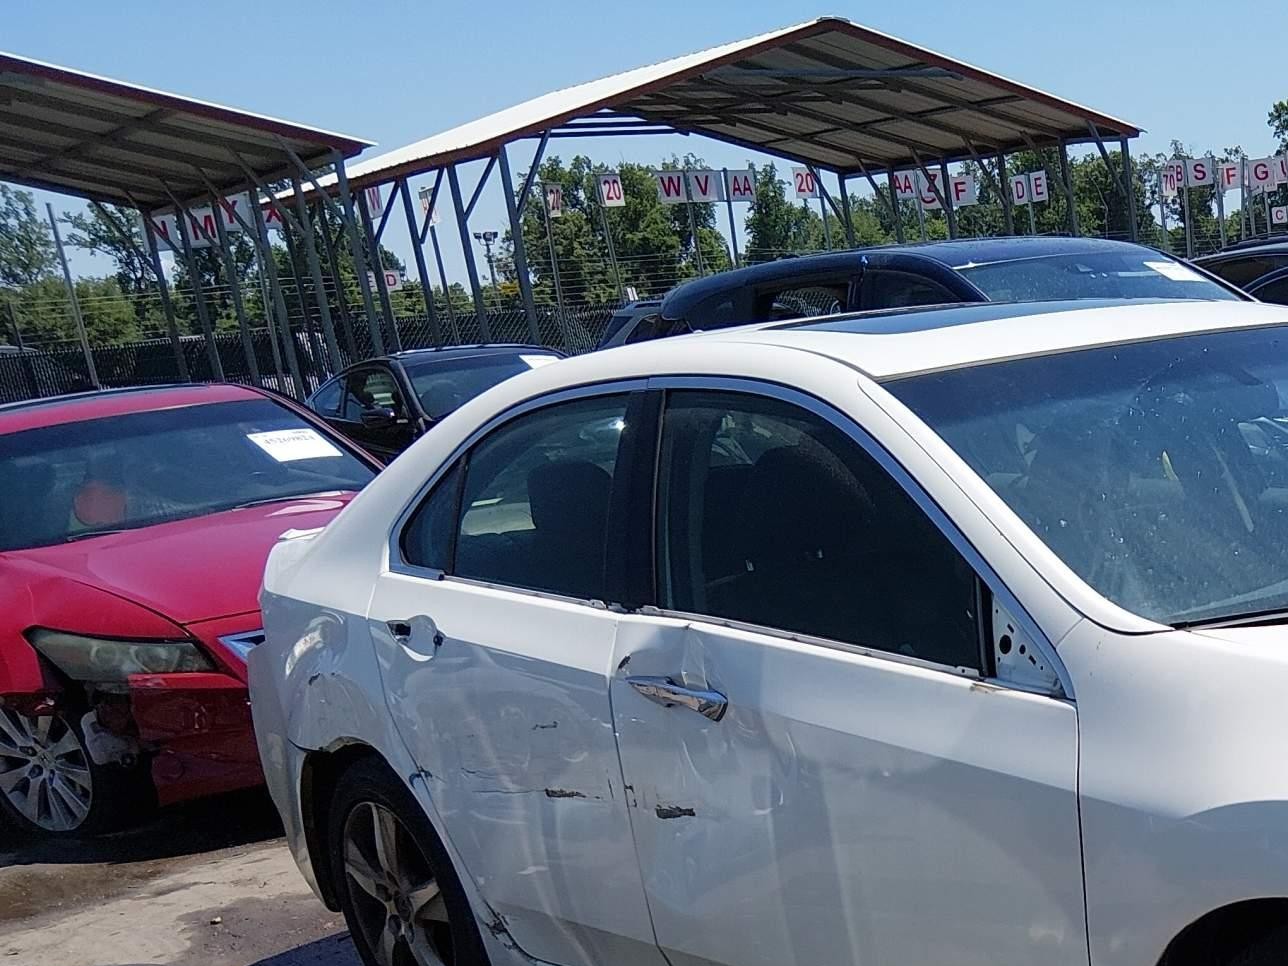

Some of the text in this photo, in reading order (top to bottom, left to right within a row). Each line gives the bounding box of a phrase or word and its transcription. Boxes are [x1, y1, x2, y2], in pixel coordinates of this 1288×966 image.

[1193, 163, 1206, 180] S
[1225, 167, 1236, 184] F
[1254, 163, 1268, 180] G
[603, 179, 621, 200] 20
[660, 176, 681, 197] W
[695, 175, 709, 196] V
[733, 176, 753, 196] AA
[796, 172, 815, 192] 20
[1015, 181, 1025, 199] D
[1034, 177, 1043, 195] E
[1163, 174, 1175, 191] 70
[954, 182, 966, 201] F
[191, 215, 217, 241] M
[386, 274, 397, 286] D
